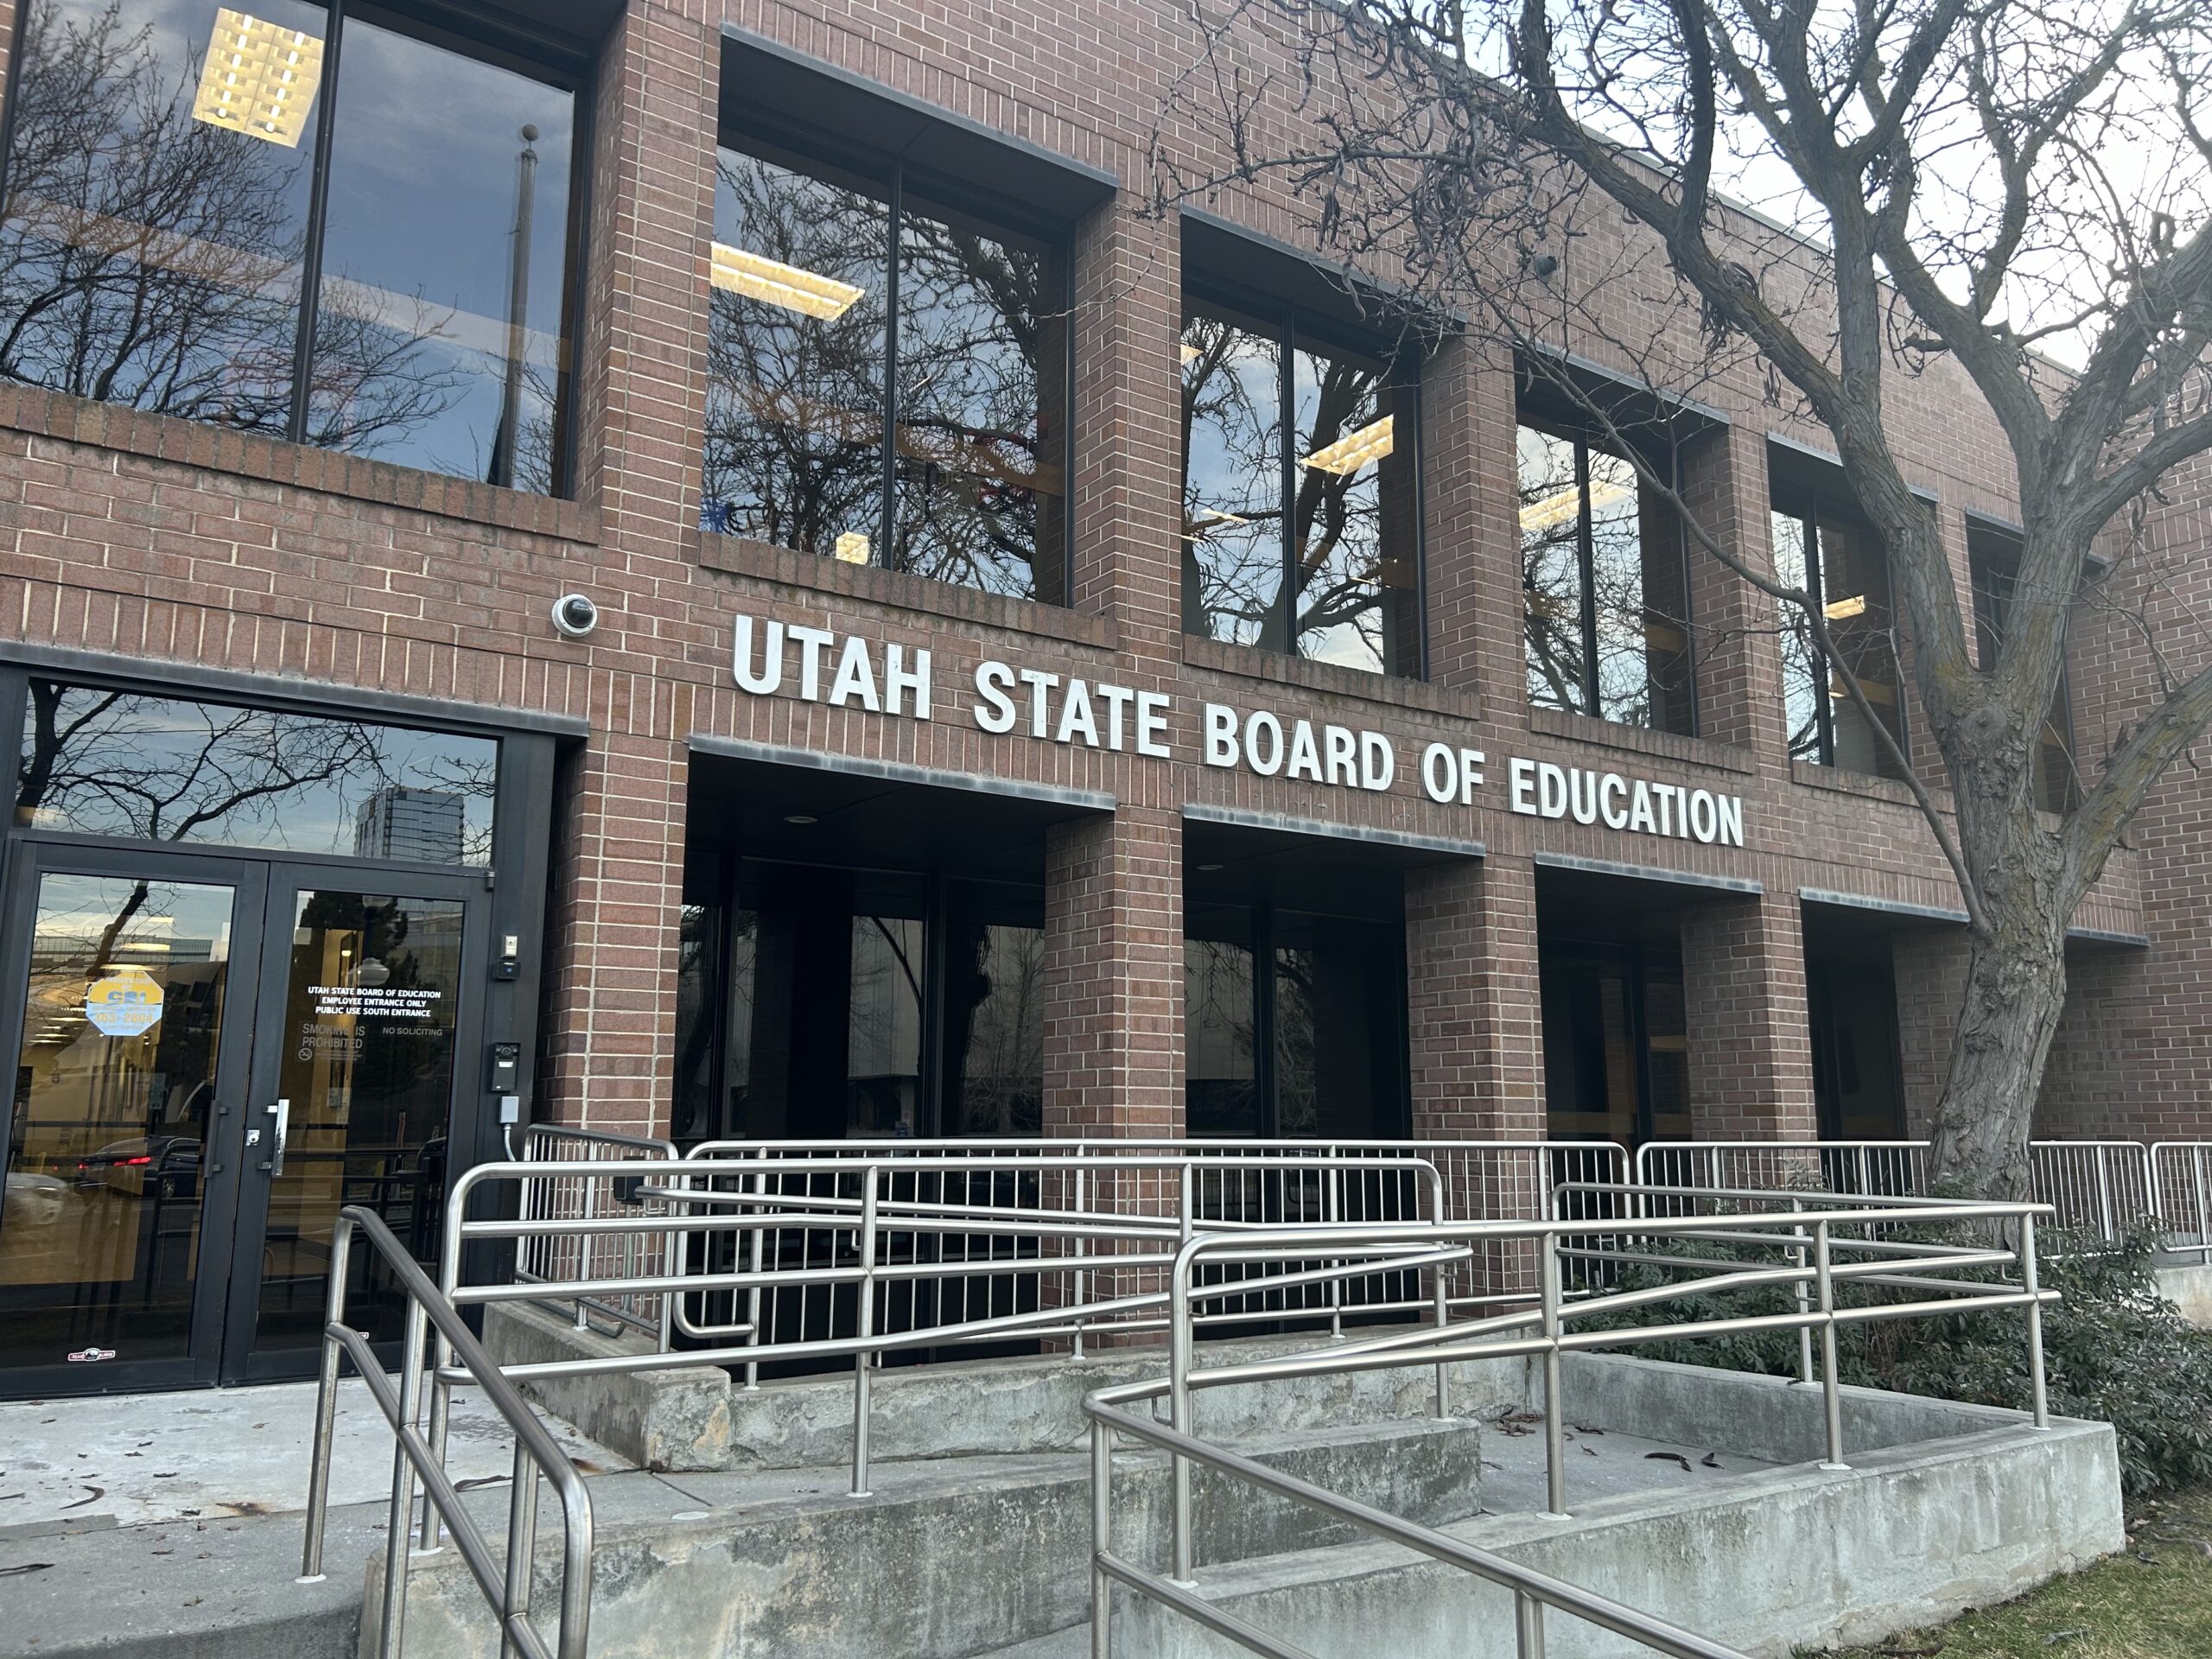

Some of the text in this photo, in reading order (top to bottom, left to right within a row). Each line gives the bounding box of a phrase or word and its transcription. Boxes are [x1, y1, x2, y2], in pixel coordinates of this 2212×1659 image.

[732, 614, 1745, 847] UTAH STATE BOARD OF EDUCATION
[357, 988, 384, 996] BOARD
[398, 989, 441, 998] EDUCATION
[364, 998, 404, 1007] ENTRANCE
[363, 1007, 389, 1016] SOUTH
[391, 1008, 431, 1017] ENTRANCE
[302, 1023, 365, 1036] SMOKING IS
[397, 1027, 442, 1036] SOLICITING
[302, 1036, 363, 1049] PROHIBITED
